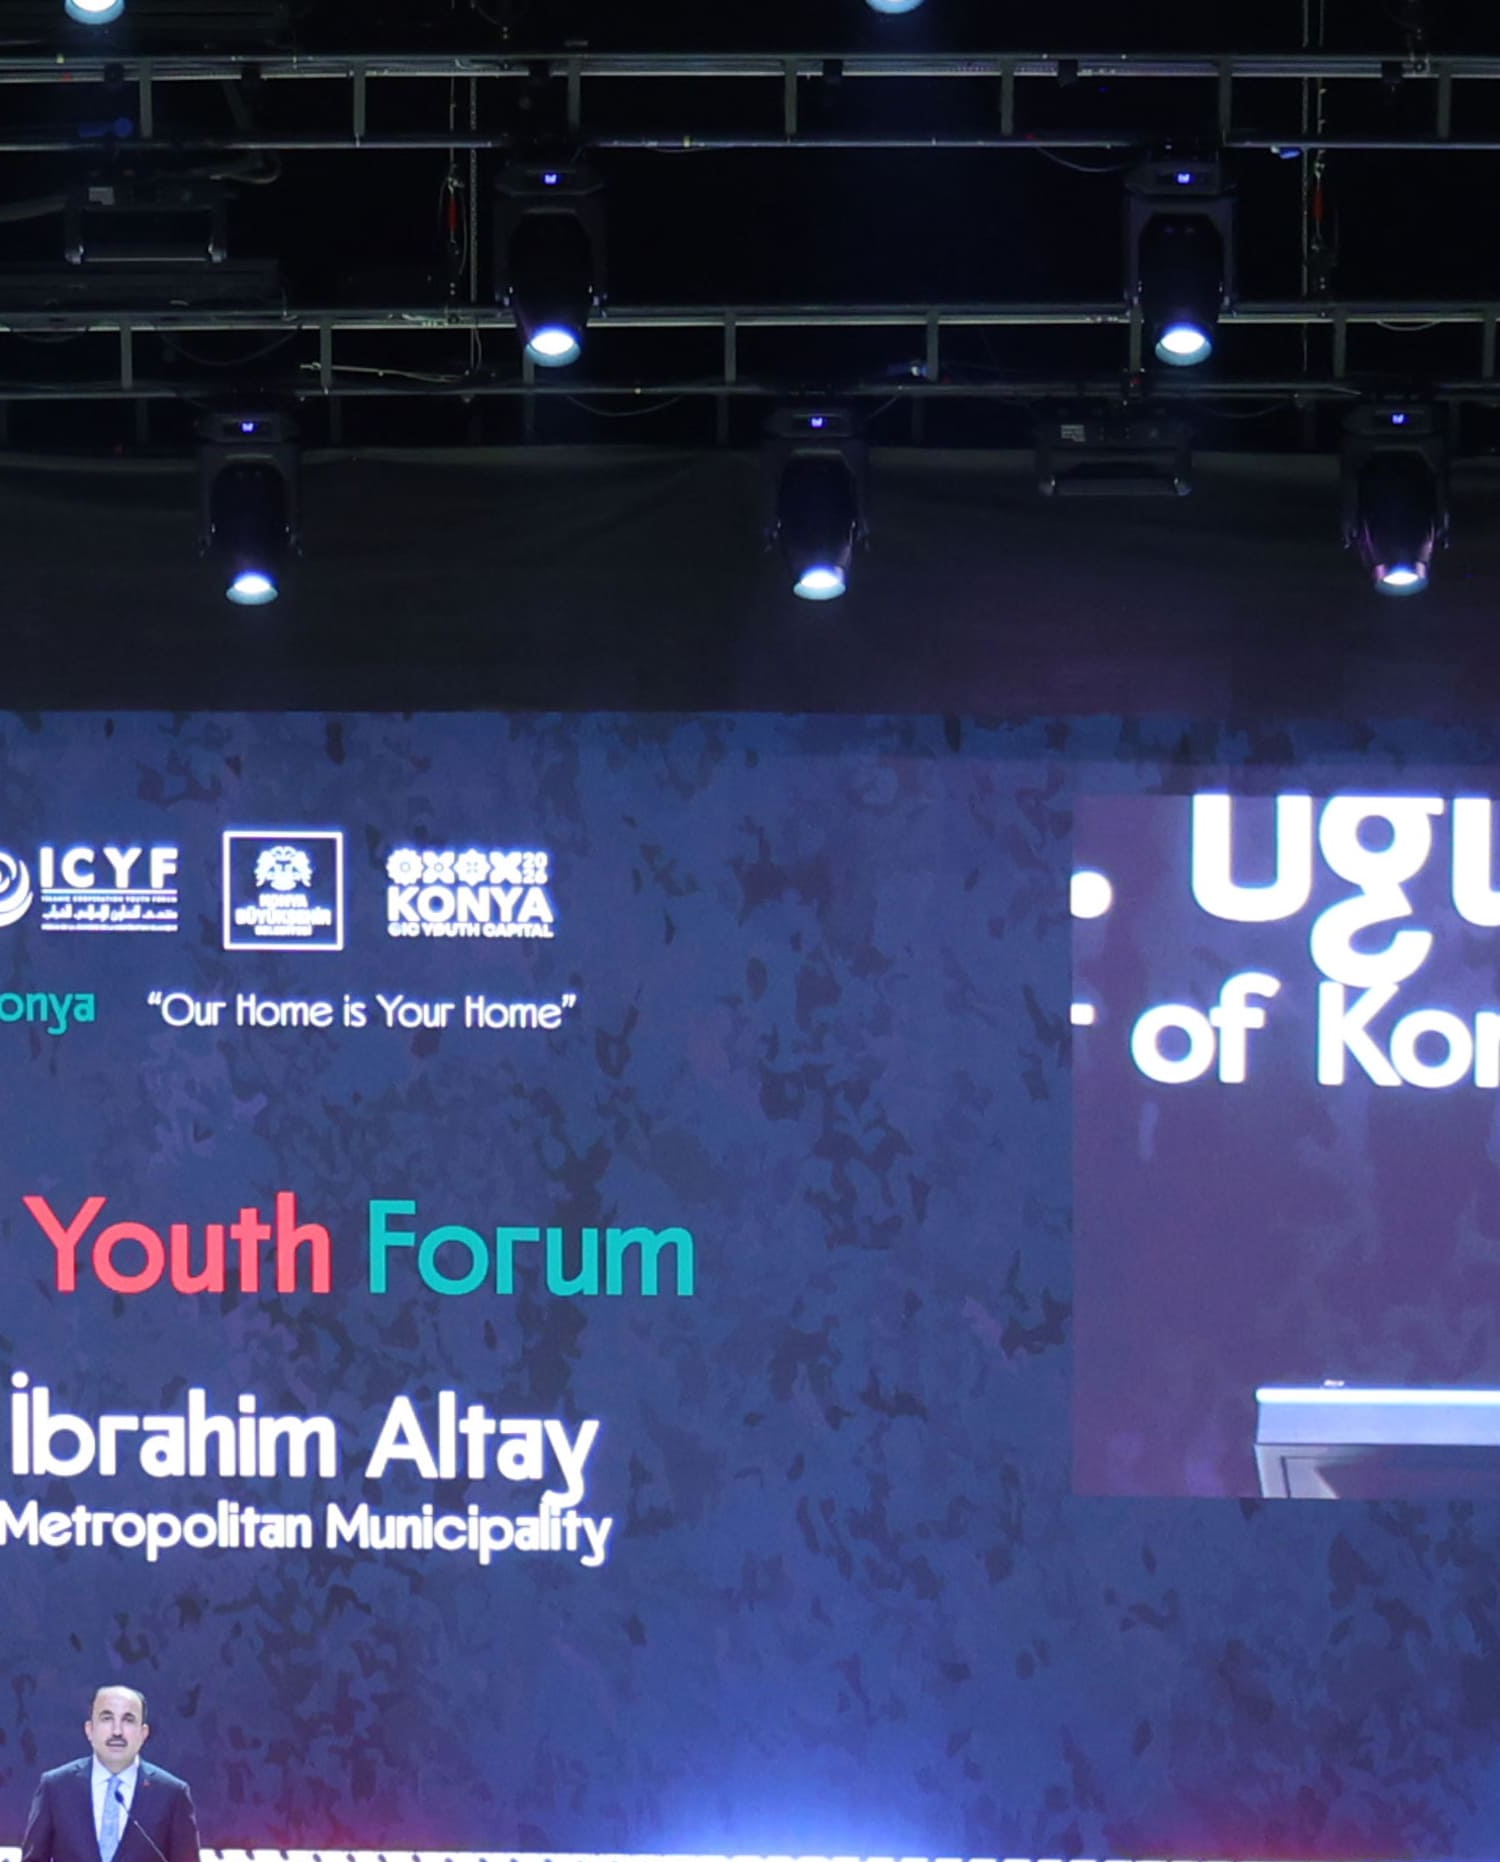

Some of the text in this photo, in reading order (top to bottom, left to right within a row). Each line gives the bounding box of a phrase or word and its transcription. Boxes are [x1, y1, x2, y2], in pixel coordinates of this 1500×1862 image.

[40, 847, 178, 888] ICYF
[387, 886, 555, 923] KONYA
[422, 922, 480, 937] YOUTH
[483, 922, 555, 938] CAPITAL
[147, 992, 577, 1029] “Our Home is Your Home”
[1131, 973, 1280, 1083] of
[23, 1192, 332, 1294] Youth
[369, 1200, 694, 1296] Forum
[10, 1372, 337, 1478] İbrahim
[366, 1391, 600, 1506] Altay
[326, 1496, 613, 1566] Municipality
